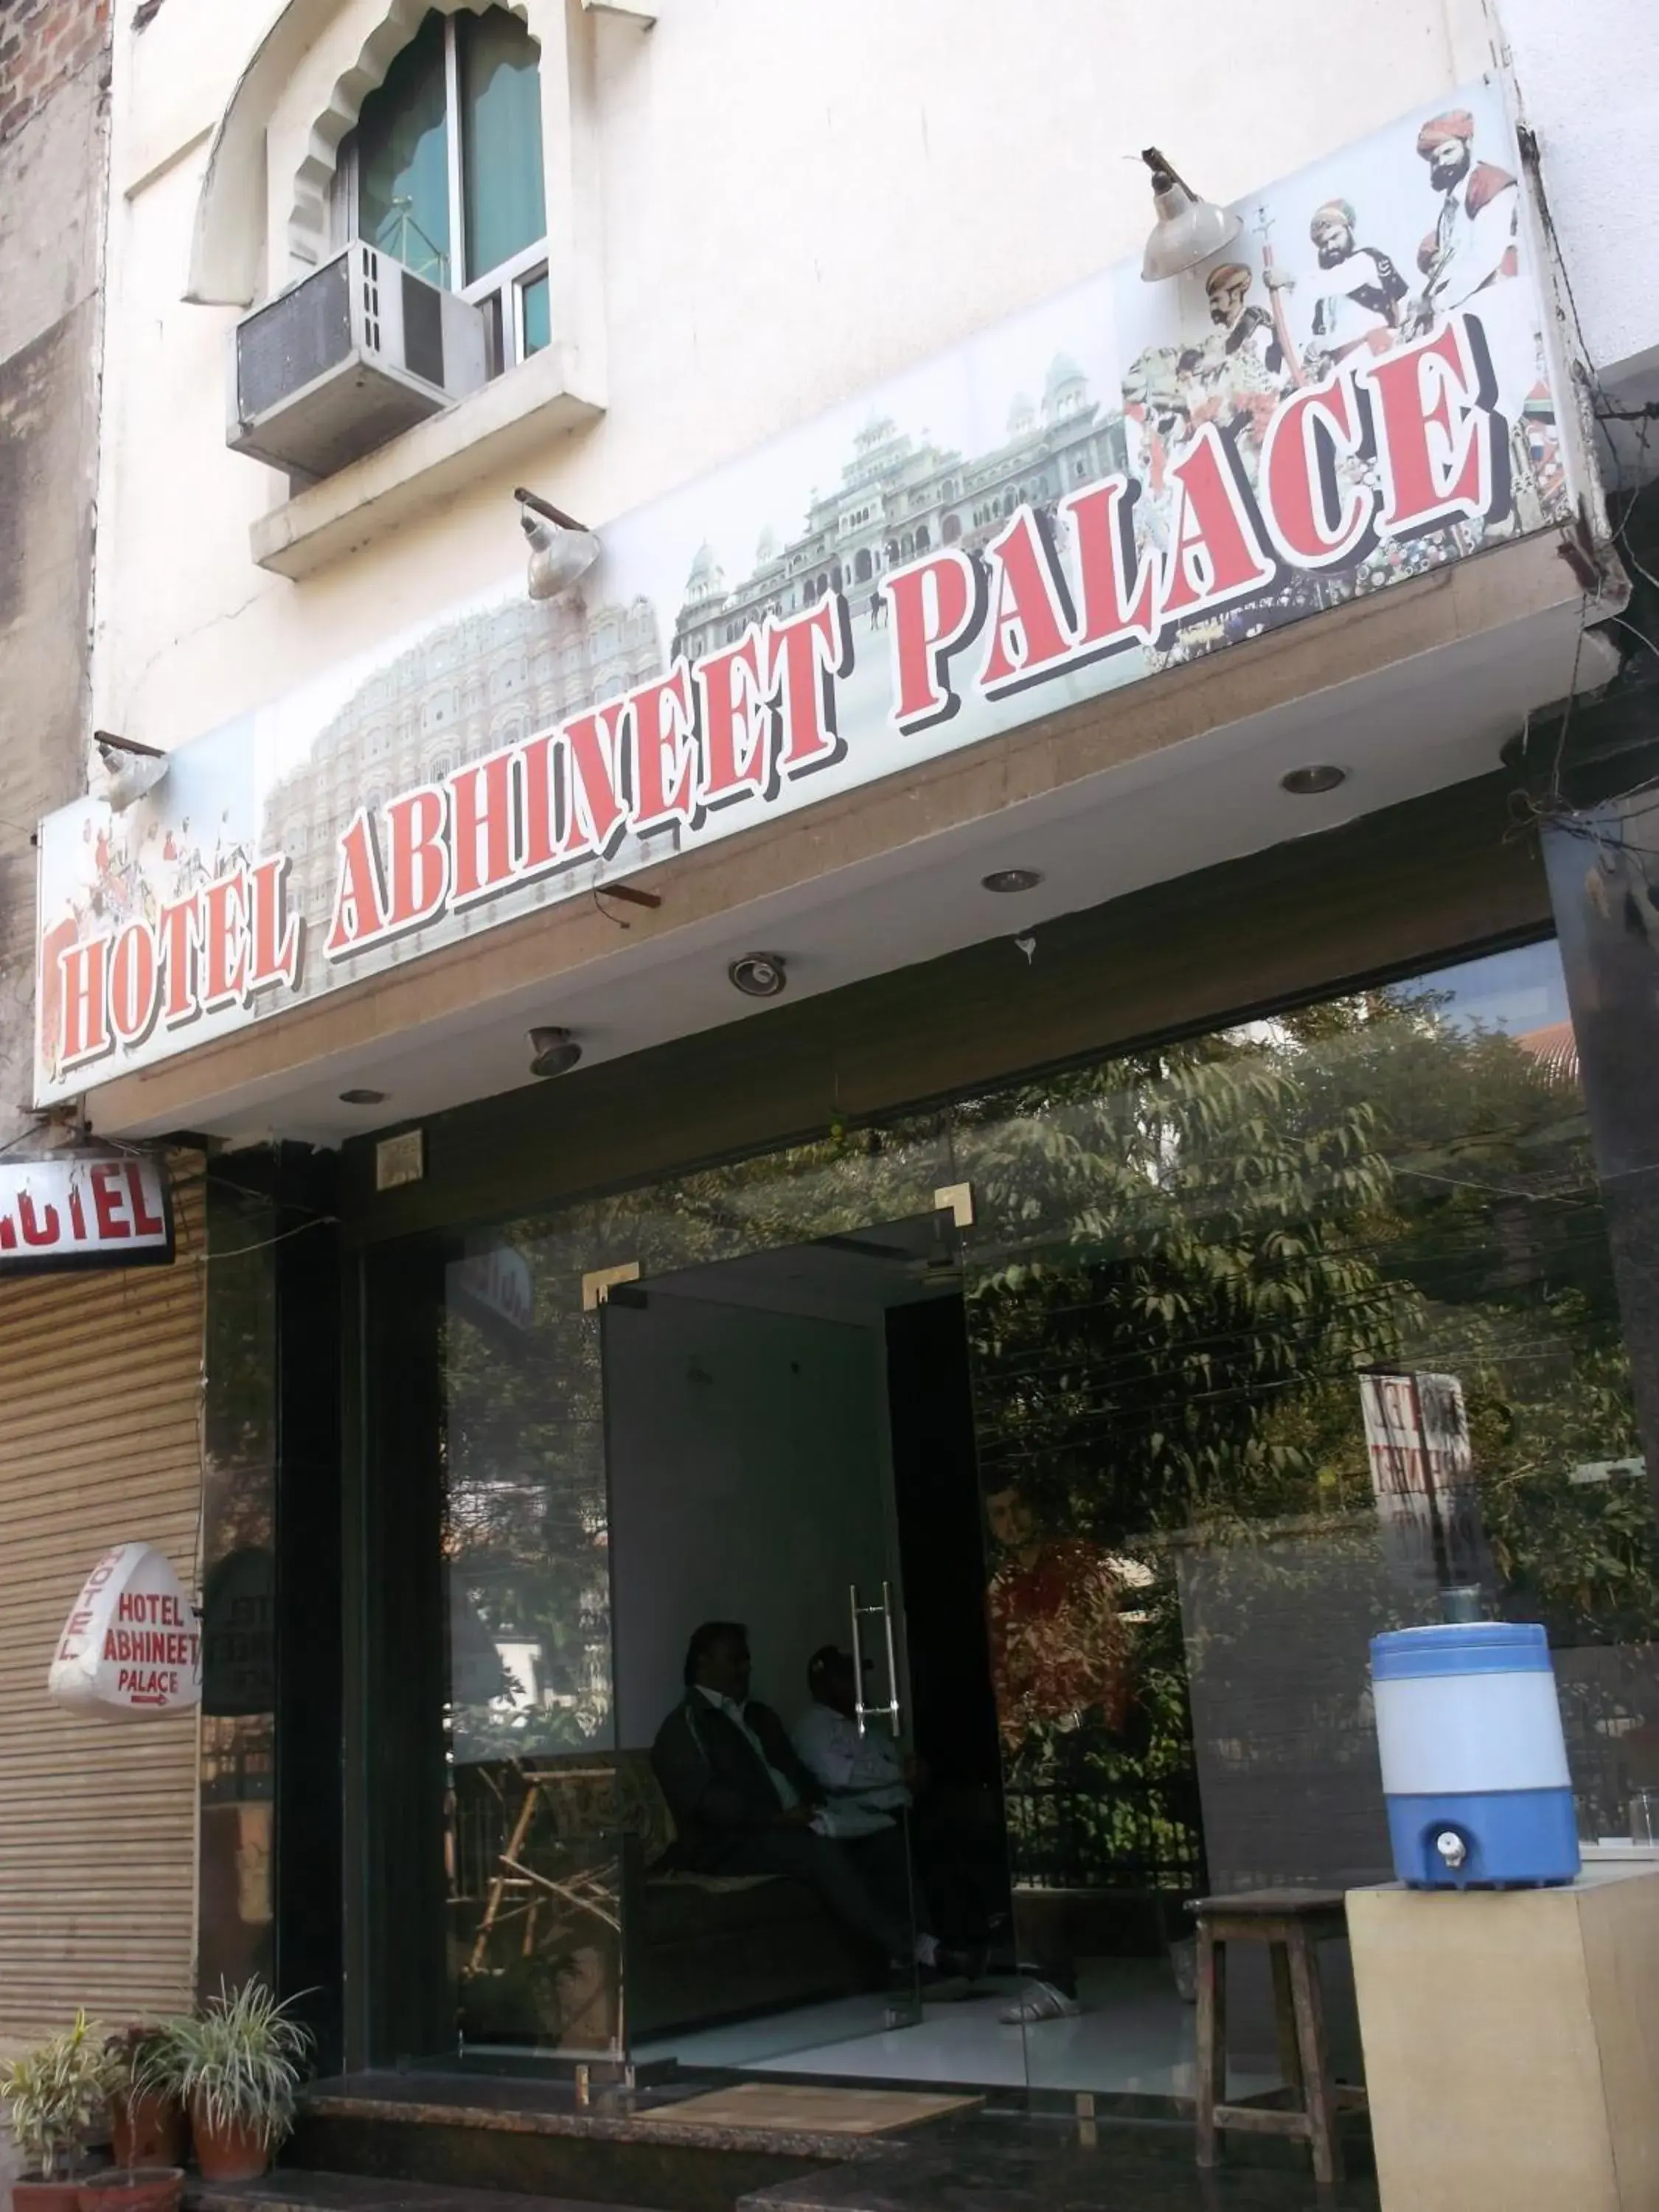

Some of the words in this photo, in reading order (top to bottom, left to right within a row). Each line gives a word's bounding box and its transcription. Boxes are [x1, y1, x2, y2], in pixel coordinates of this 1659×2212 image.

[59, 852, 304, 1073] HOTEL
[323, 588, 853, 964] ABHINEET
[880, 311, 1510, 735] PALACE
[118, 1592, 183, 1627] HOTEL
[103, 1630, 198, 1666] ABHINEET
[117, 1669, 178, 1694] PALACE
